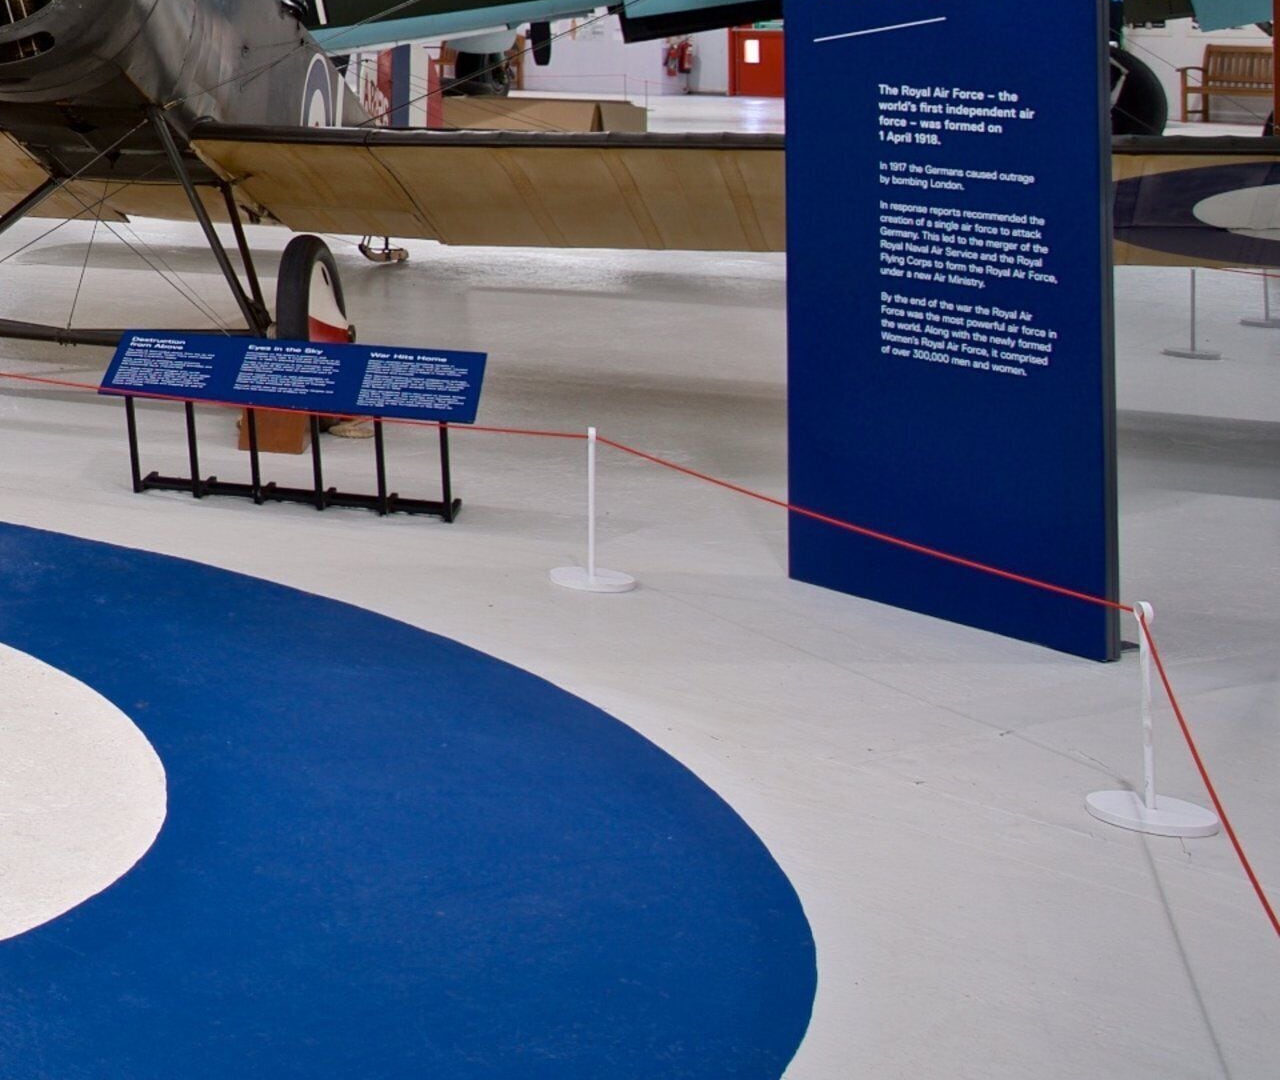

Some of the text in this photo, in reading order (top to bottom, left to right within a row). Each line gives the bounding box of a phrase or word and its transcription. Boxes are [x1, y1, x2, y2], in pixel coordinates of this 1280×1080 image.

[879, 84, 899, 96] The
[901, 85, 931, 99] Royal
[933, 87, 950, 99] Air
[953, 87, 985, 101] Force
[998, 90, 1018, 103] the
[879, 100, 1035, 120] world's first independent air
[879, 115, 907, 128] force
[920, 120, 942, 130] was
[944, 119, 985, 133] formed
[988, 124, 1002, 134] on
[879, 130, 941, 145] 1 April 1918.
[880, 161, 1035, 185] In 1917 the Germans caused outrage
[880, 174, 890, 186] by
[892, 175, 928, 190] bombing
[880, 200, 1045, 227] In response reports recommended the
[880, 215, 914, 226] creation
[915, 217, 925, 227] of
[934, 220, 959, 232] single
[961, 222, 972, 232] air
[975, 223, 998, 235] force
[1000, 227, 1010, 237] to
[1012, 229, 1042, 240] attack
[880, 239, 1043, 269] Royal Naval Air Service and the Royal
[922, 230, 940, 242] This
[942, 233, 955, 244] led
[957, 236, 967, 245] to
[969, 237, 984, 247] the
[986, 240, 1018, 252] merger
[1020, 242, 1031, 252] of
[1033, 244, 1049, 255] the
[880, 267, 904, 277] under
[914, 271, 932, 281] new
[934, 272, 946, 283] Air
[881, 252, 905, 267] Flying
[907, 255, 933, 269] Corps
[934, 260, 944, 269] to
[946, 260, 967, 272] form
[969, 263, 984, 275] the
[986, 265, 1011, 278] Royal
[1013, 269, 1026, 279] Air
[881, 291, 1033, 322] By the end of the war the Royal Air
[881, 304, 1057, 339] Force was the most powerful air force in
[132, 336, 186, 345] Destruction
[881, 318, 895, 329] the
[924, 324, 950, 340] Along
[952, 330, 971, 340] with
[972, 332, 988, 343] the
[989, 336, 1016, 349] newly
[1018, 338, 1052, 353] formed
[248, 344, 271, 352] Eyes
[304, 347, 323, 355] Sky
[881, 331, 920, 346] Women's
[921, 337, 945, 350] Royal
[946, 341, 959, 352] Air
[992, 348, 998, 358] it
[1000, 351, 1049, 366] comprised
[881, 345, 891, 354] of
[892, 347, 911, 357] over
[913, 349, 950, 364] 300,000
[951, 357, 971, 368] men
[973, 361, 990, 371] and
